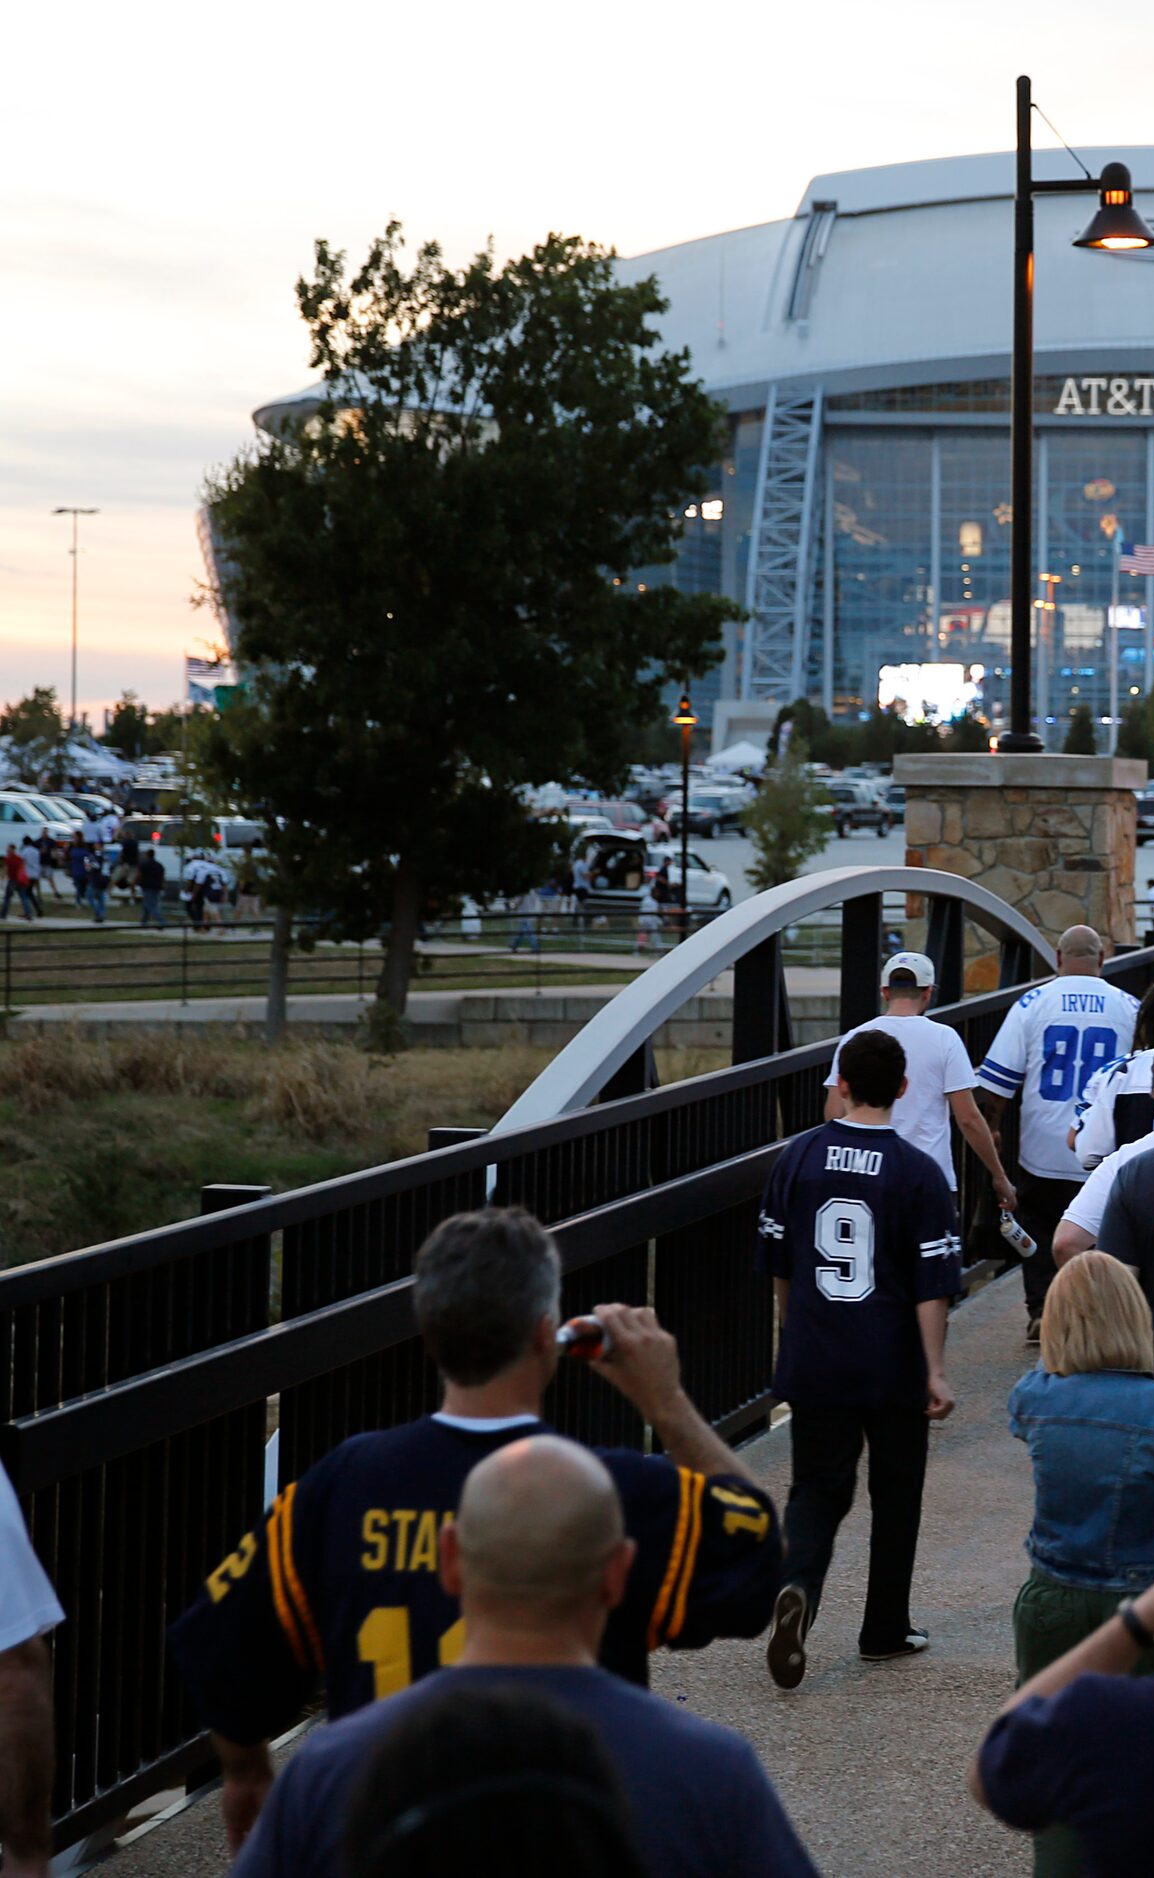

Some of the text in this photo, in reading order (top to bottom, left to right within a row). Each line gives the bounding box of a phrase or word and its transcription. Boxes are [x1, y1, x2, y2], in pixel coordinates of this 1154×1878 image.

[1061, 994, 1105, 1013] IRVIN
[1039, 1025, 1118, 1102] 88
[825, 1145, 883, 1175] ROMO
[814, 1198, 876, 1301] 9
